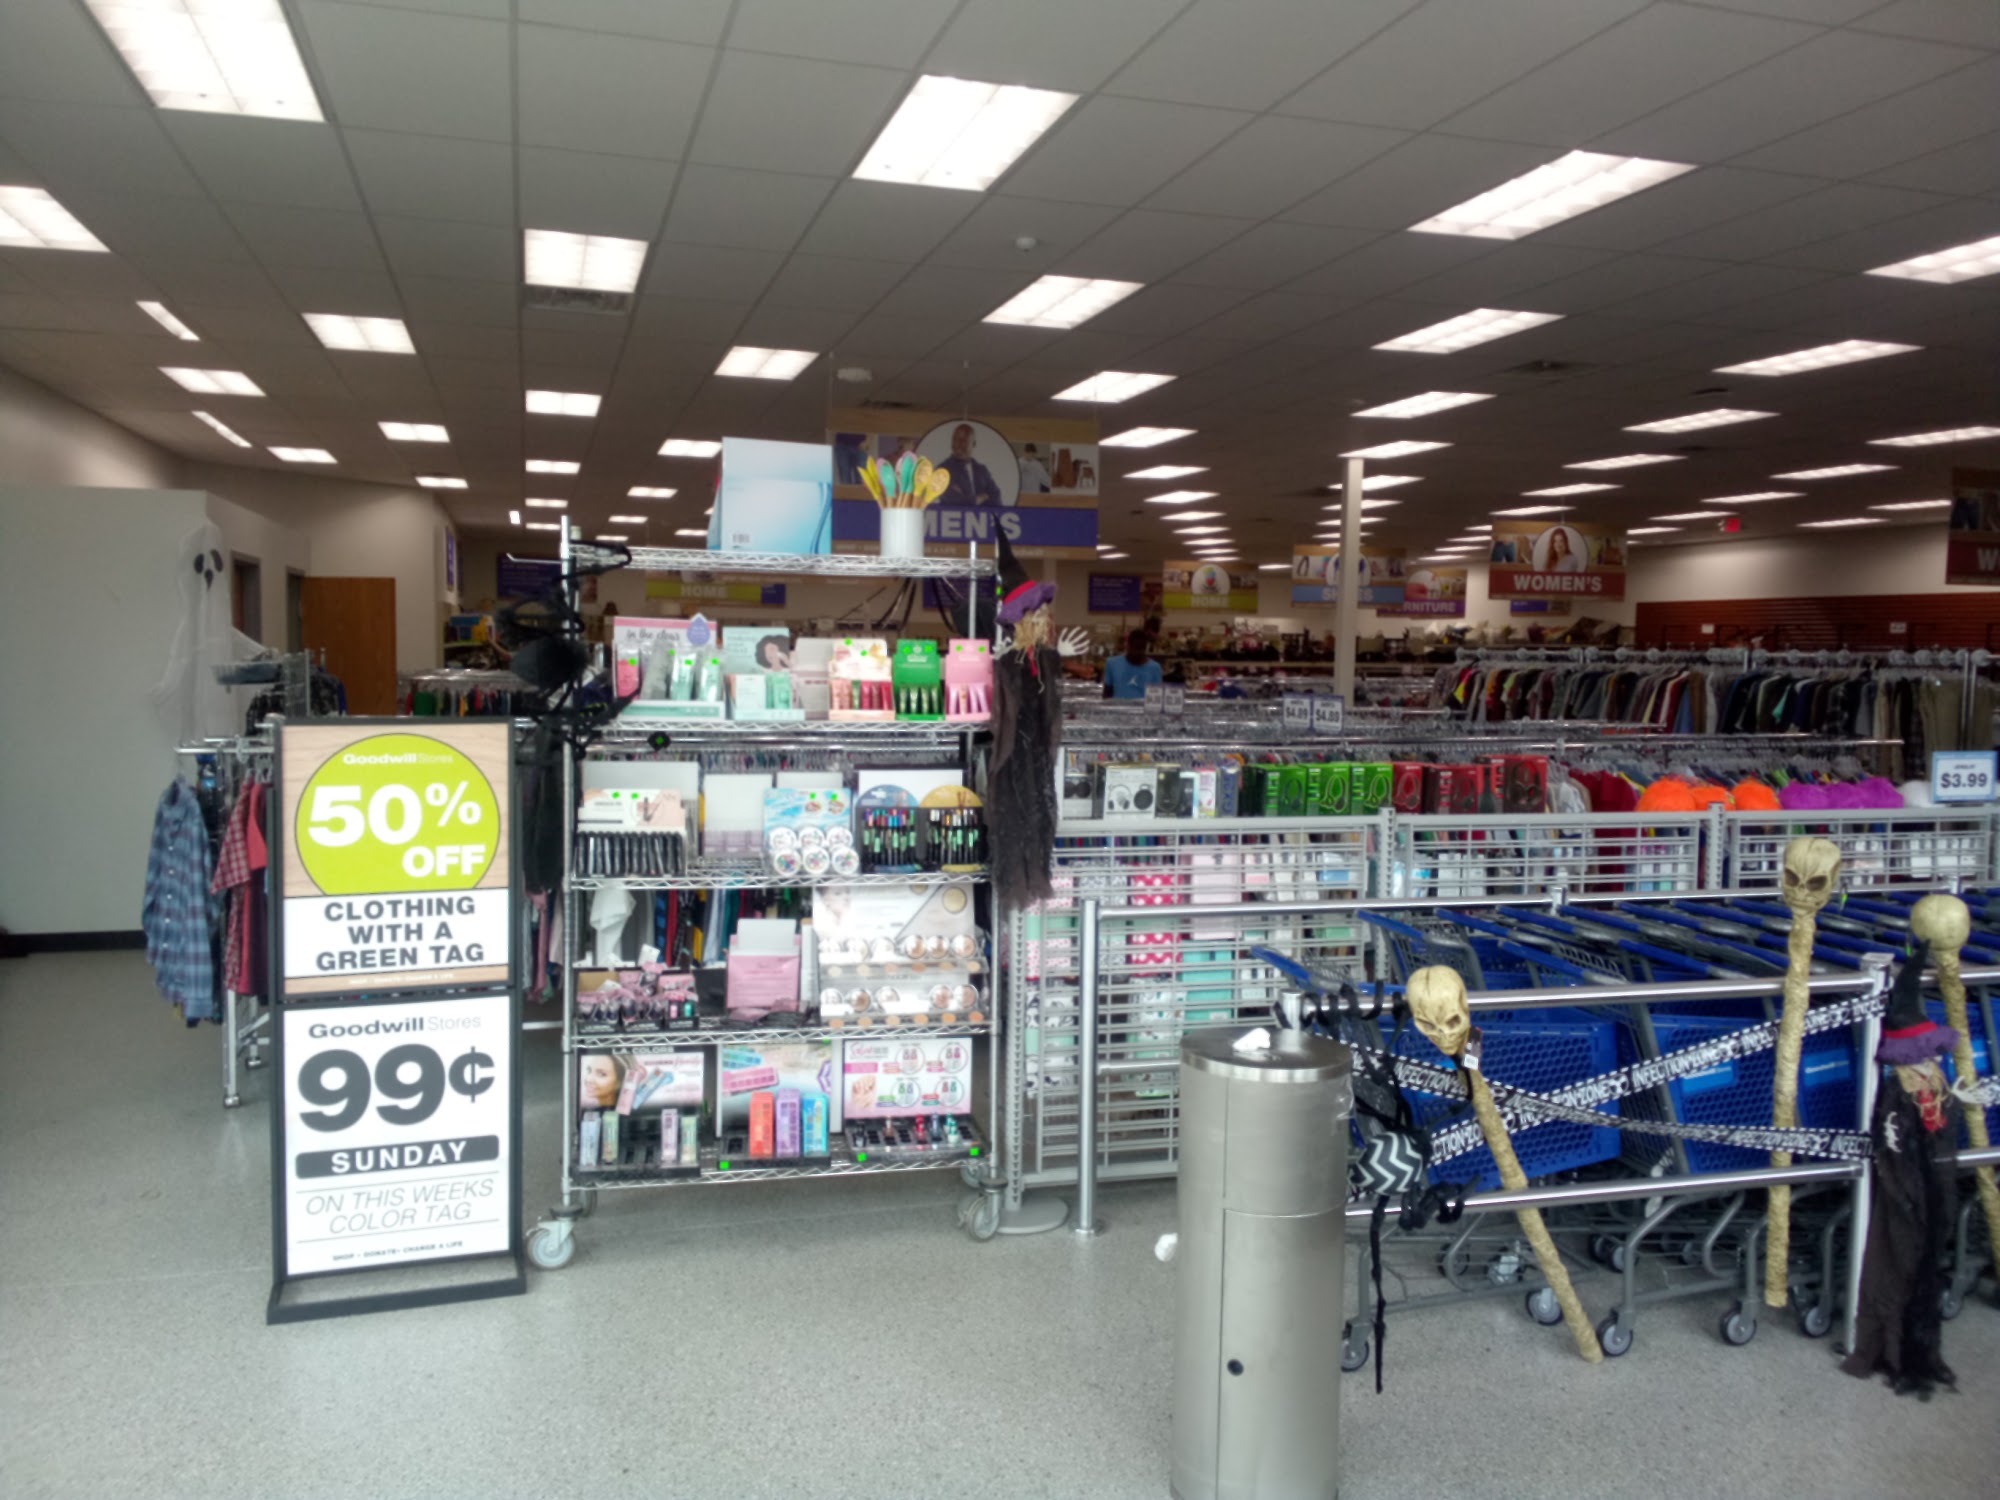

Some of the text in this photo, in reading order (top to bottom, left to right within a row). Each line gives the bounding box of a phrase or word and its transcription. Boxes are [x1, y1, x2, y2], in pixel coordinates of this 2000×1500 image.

[680, 583, 728, 598] HOME
[1322, 587, 1373, 600] SHES
[1513, 574, 1602, 592] WOMEN'S
[1395, 601, 1456, 612] RNITURE
[342, 753, 454, 765] Goodwill Stores
[1941, 772, 1988, 788] $3.99
[308, 781, 482, 847] 50%
[402, 844, 487, 878] OFF
[324, 896, 476, 922] CLOTHING
[348, 921, 454, 945] WITH A
[316, 943, 485, 971] GREEN TAG
[308, 1015, 482, 1039] Goodwill Stores
[1394, 1062, 1469, 1097] INFECTION ZO
[1632, 1055, 1690, 1088] INFECTION
[299, 1044, 496, 1132] 99¢
[1431, 1123, 1484, 1158] CTION ZO
[1831, 1135, 1873, 1155] INFECTI
[331, 1141, 467, 1173] SUNDAY
[306, 1178, 494, 1216] ON THIS WEEKS
[329, 1202, 472, 1234] COLOR TAG
[403, 1243, 436, 1254] CHANGE
[446, 1240, 463, 1249] LIFE
